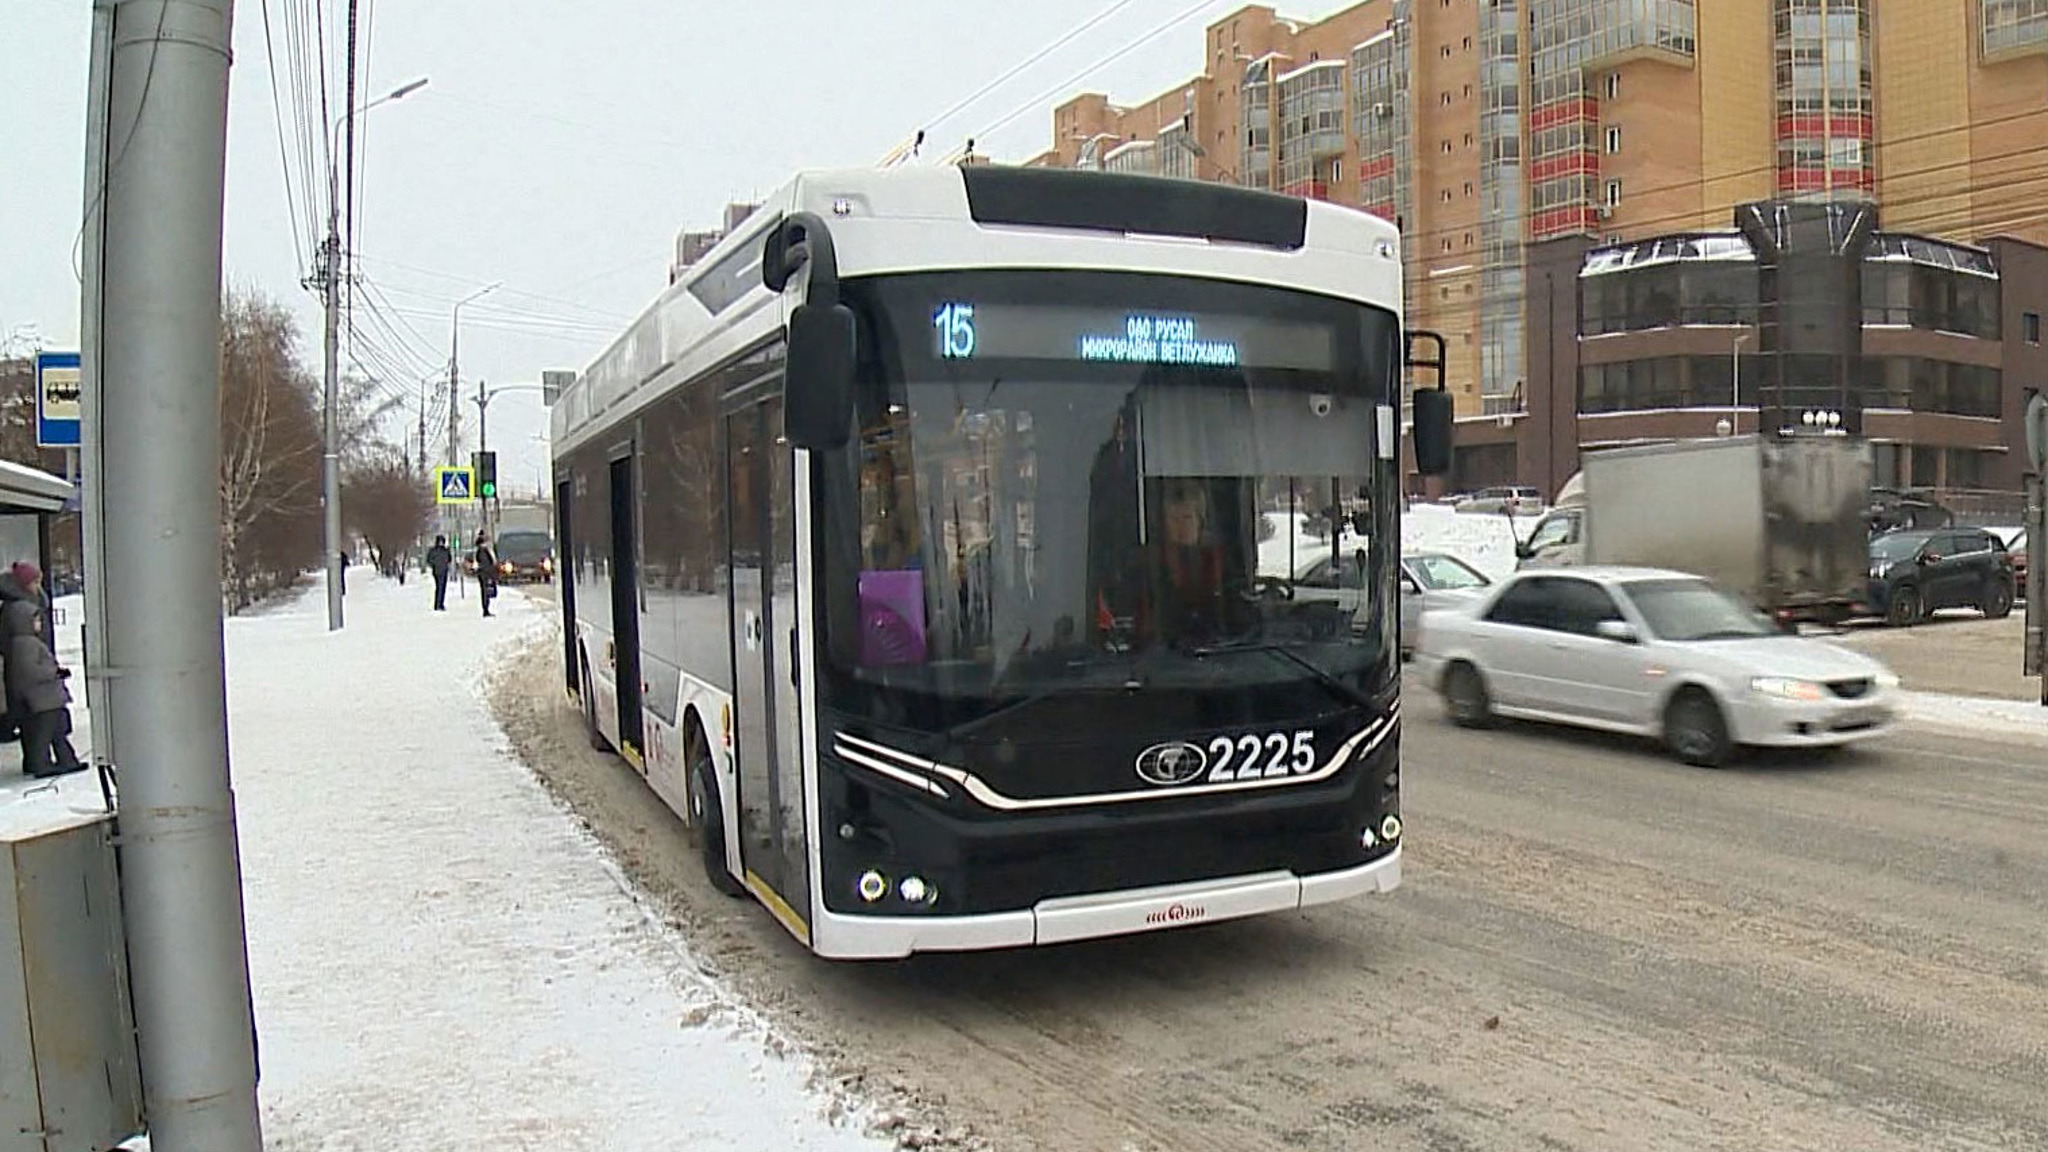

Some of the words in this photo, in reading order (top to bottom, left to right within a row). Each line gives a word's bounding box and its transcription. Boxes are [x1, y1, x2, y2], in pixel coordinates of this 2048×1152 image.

[935, 303, 974, 358] 15
[1127, 317, 1151, 340] ОАО
[1155, 318, 1195, 341] РУСАЛ
[1081, 336, 1157, 361] МИКРОРАЙОН
[1161, 340, 1237, 366] ВЕТЛУЖАНКА
[1208, 730, 1315, 782] 2225
